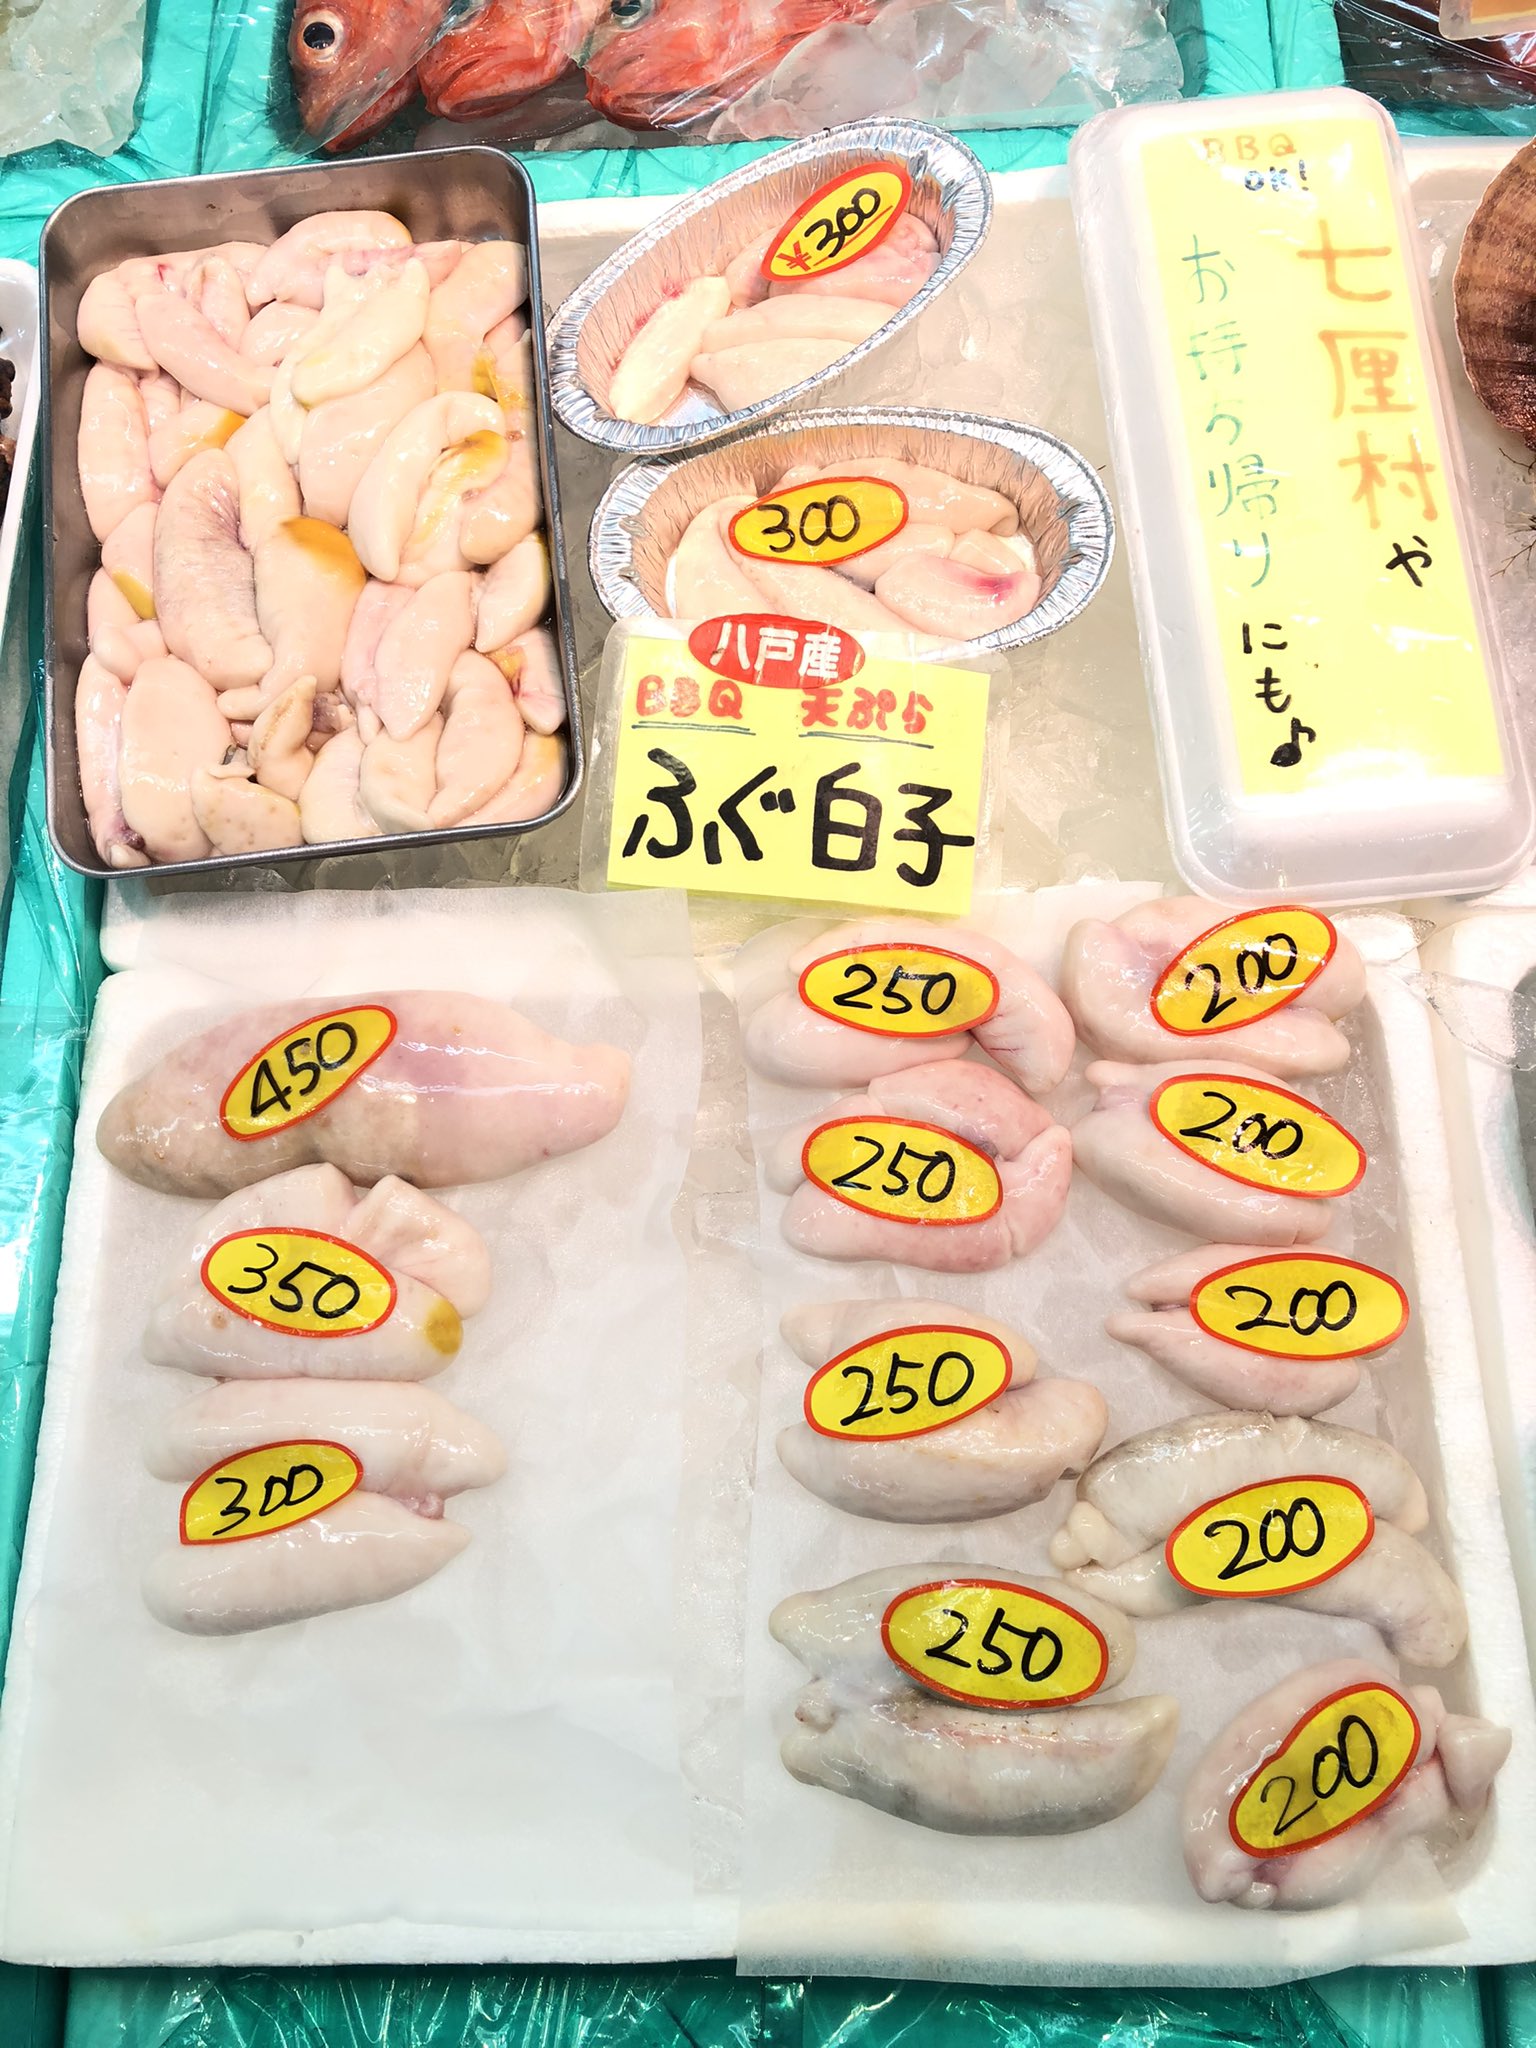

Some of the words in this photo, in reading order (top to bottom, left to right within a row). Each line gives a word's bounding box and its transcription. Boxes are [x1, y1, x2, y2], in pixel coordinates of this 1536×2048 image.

[757, 494, 862, 553] 300
[710, 622, 842, 679] 八戸産
[636, 675, 743, 720] BBQ
[801, 687, 934, 734] 天ぷら
[622, 747, 977, 887] ふぐ白子
[832, 964, 957, 1017] 250
[1184, 932, 1298, 1024] 200
[247, 1021, 358, 1120] 450
[1179, 1091, 1304, 1160] 200
[831, 1135, 957, 1203] 250
[227, 1242, 362, 1320] 350
[1224, 1279, 1358, 1337] 200
[839, 1350, 975, 1427] 250
[212, 1464, 324, 1537] 300
[1203, 1496, 1327, 1580] 200
[924, 1606, 1064, 1683] 250
[1259, 1714, 1379, 1836] 200
